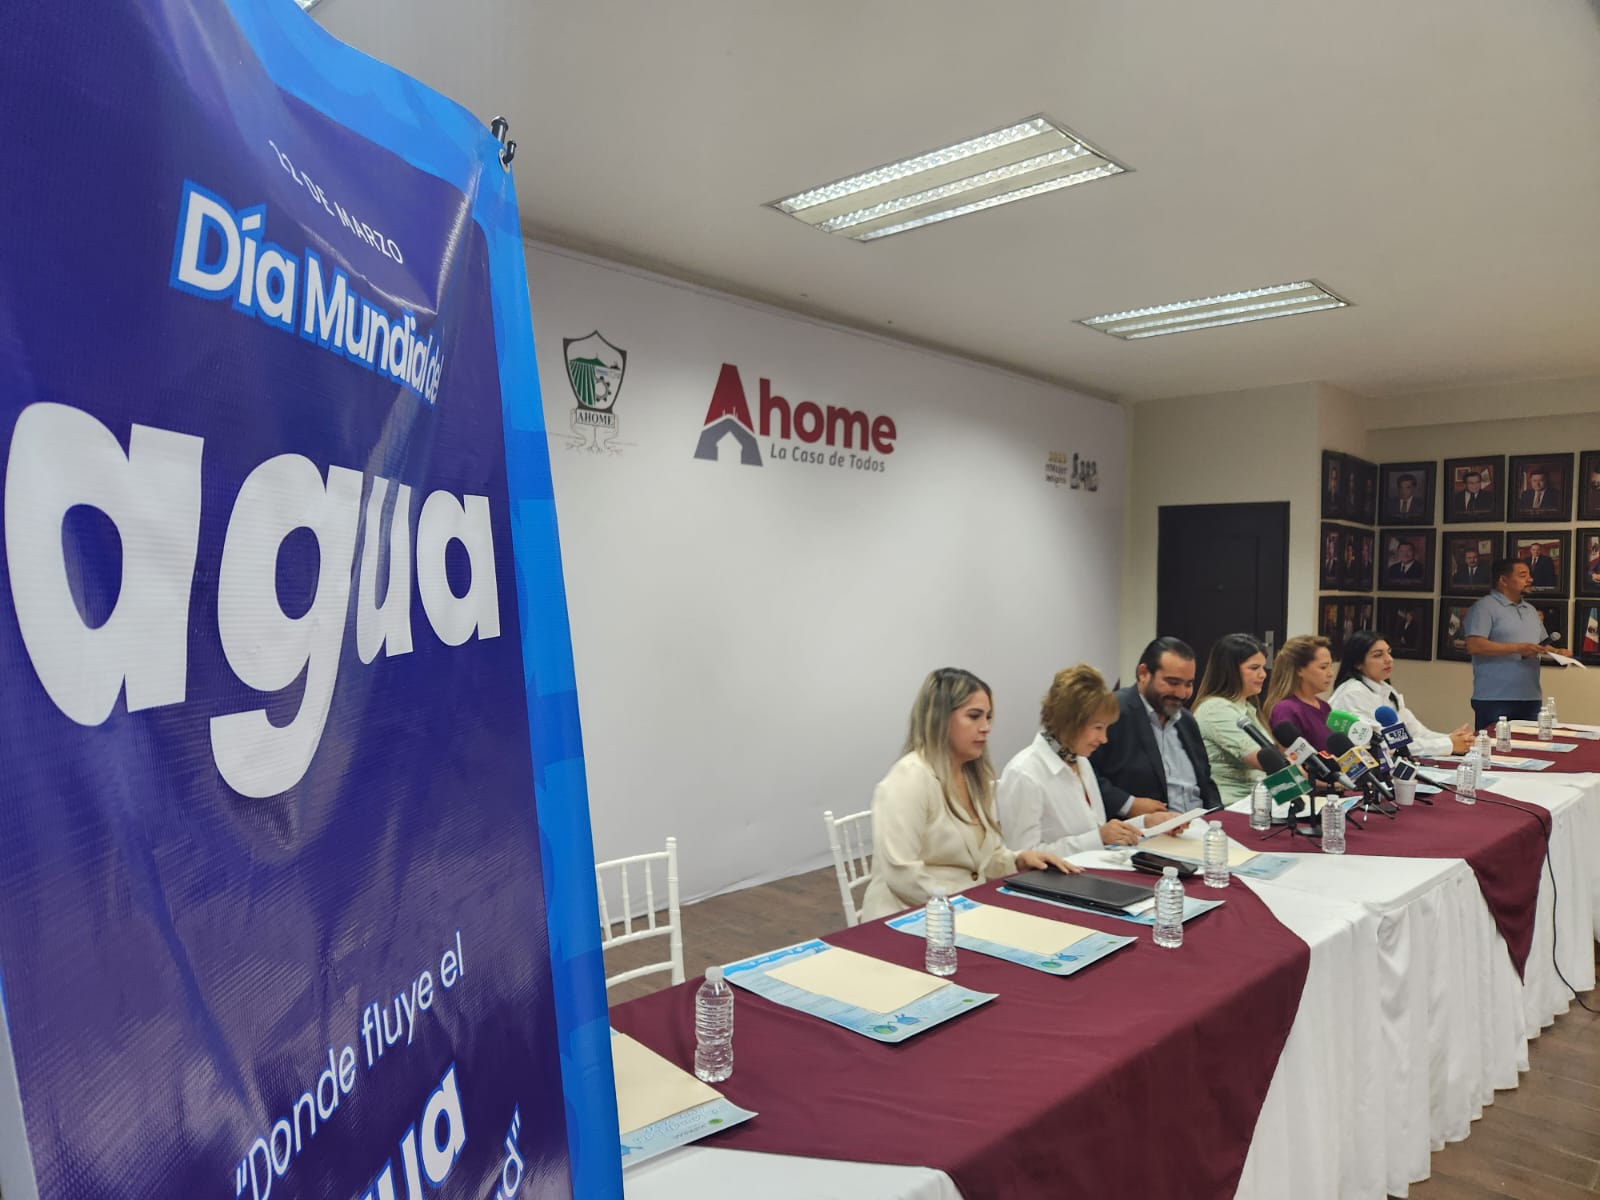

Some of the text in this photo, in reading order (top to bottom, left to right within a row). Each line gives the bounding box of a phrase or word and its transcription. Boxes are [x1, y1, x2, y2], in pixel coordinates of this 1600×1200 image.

[301, 171, 335, 216] DE
[334, 202, 403, 264] MARZO
[177, 190, 297, 325] Día
[304, 255, 433, 393] Mundial
[577, 411, 613, 425] AHOME
[694, 362, 897, 467] Ahome
[770, 444, 886, 472] La Casa de Todos
[4, 402, 500, 798] agua
[361, 969, 434, 1067] fluye
[440, 931, 465, 988] el
